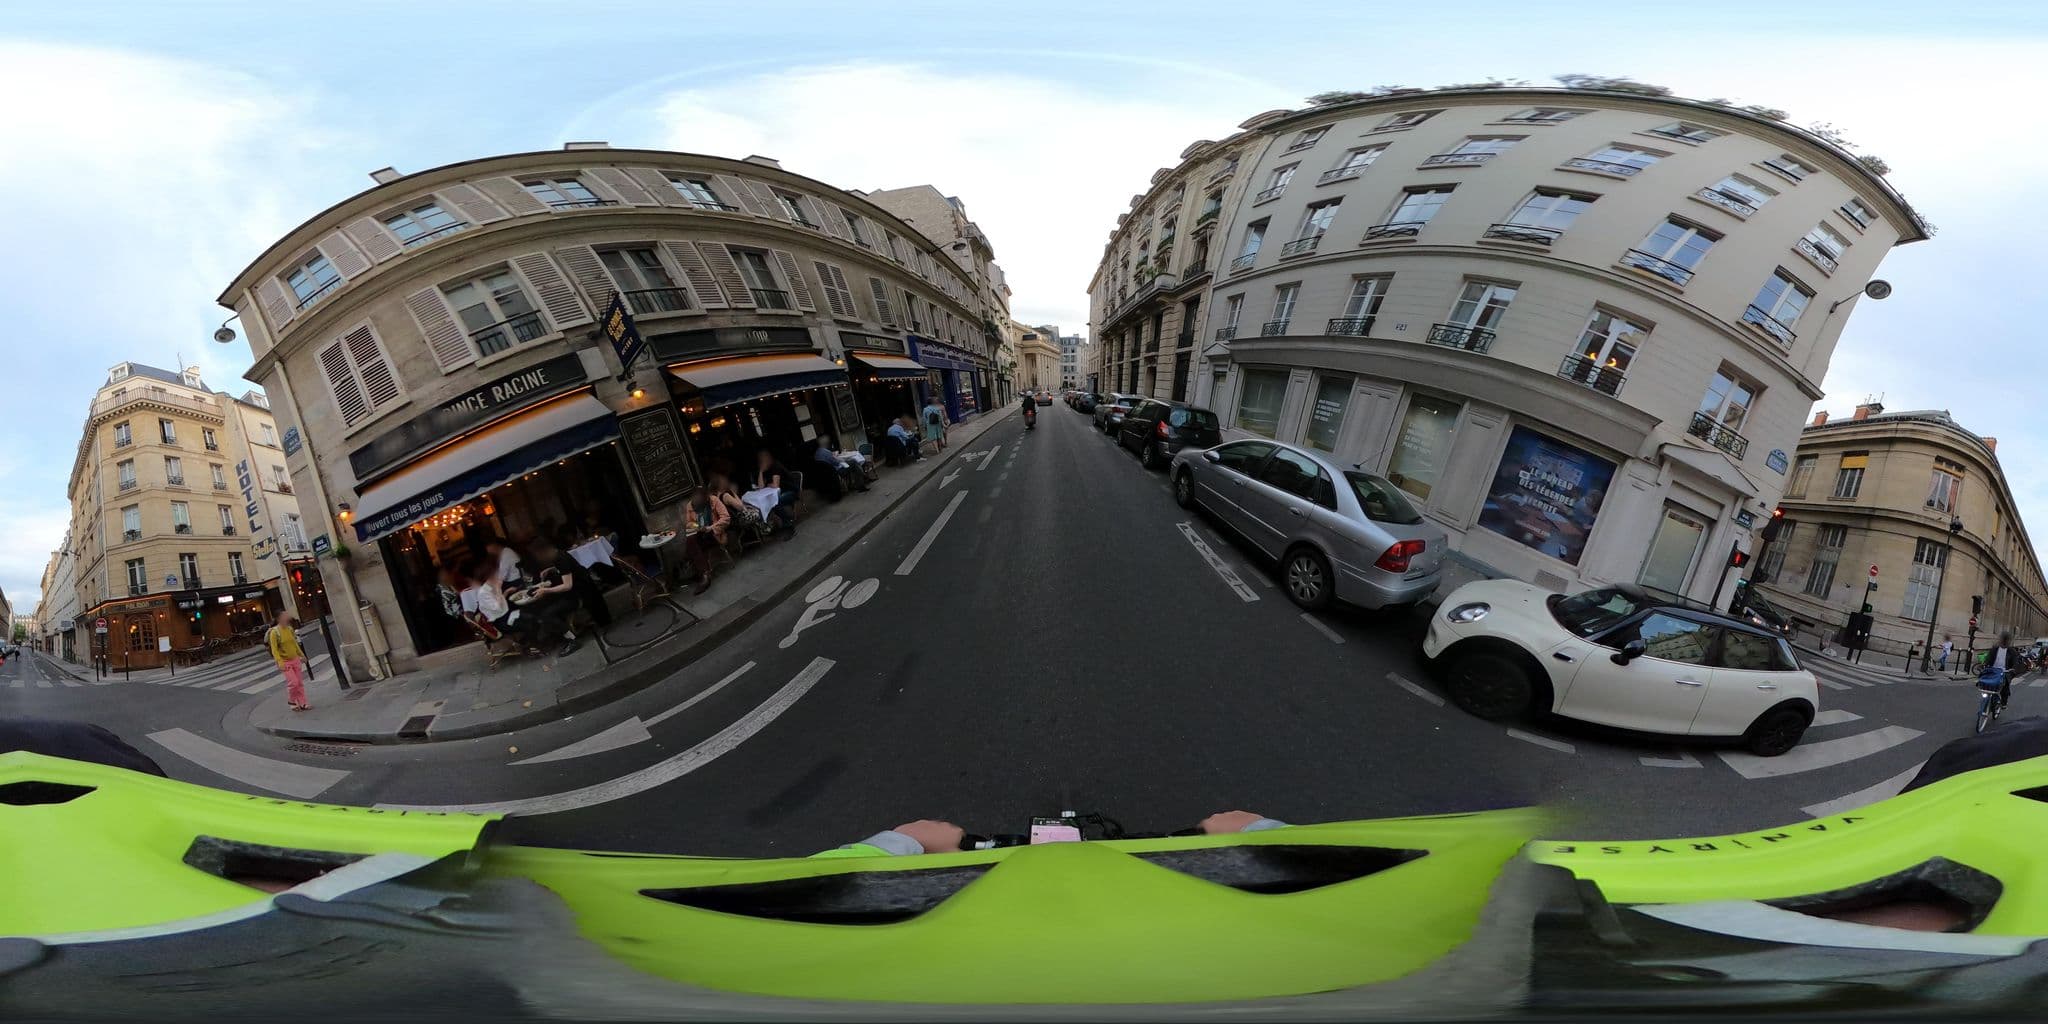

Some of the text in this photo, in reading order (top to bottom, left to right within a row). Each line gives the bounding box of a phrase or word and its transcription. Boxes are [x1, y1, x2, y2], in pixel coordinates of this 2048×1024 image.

[491, 368, 550, 402] RACINE
[235, 459, 263, 534] HOTEL
[391, 508, 409, 522] tous
[409, 502, 422, 514] les
[423, 492, 444, 510] jours
